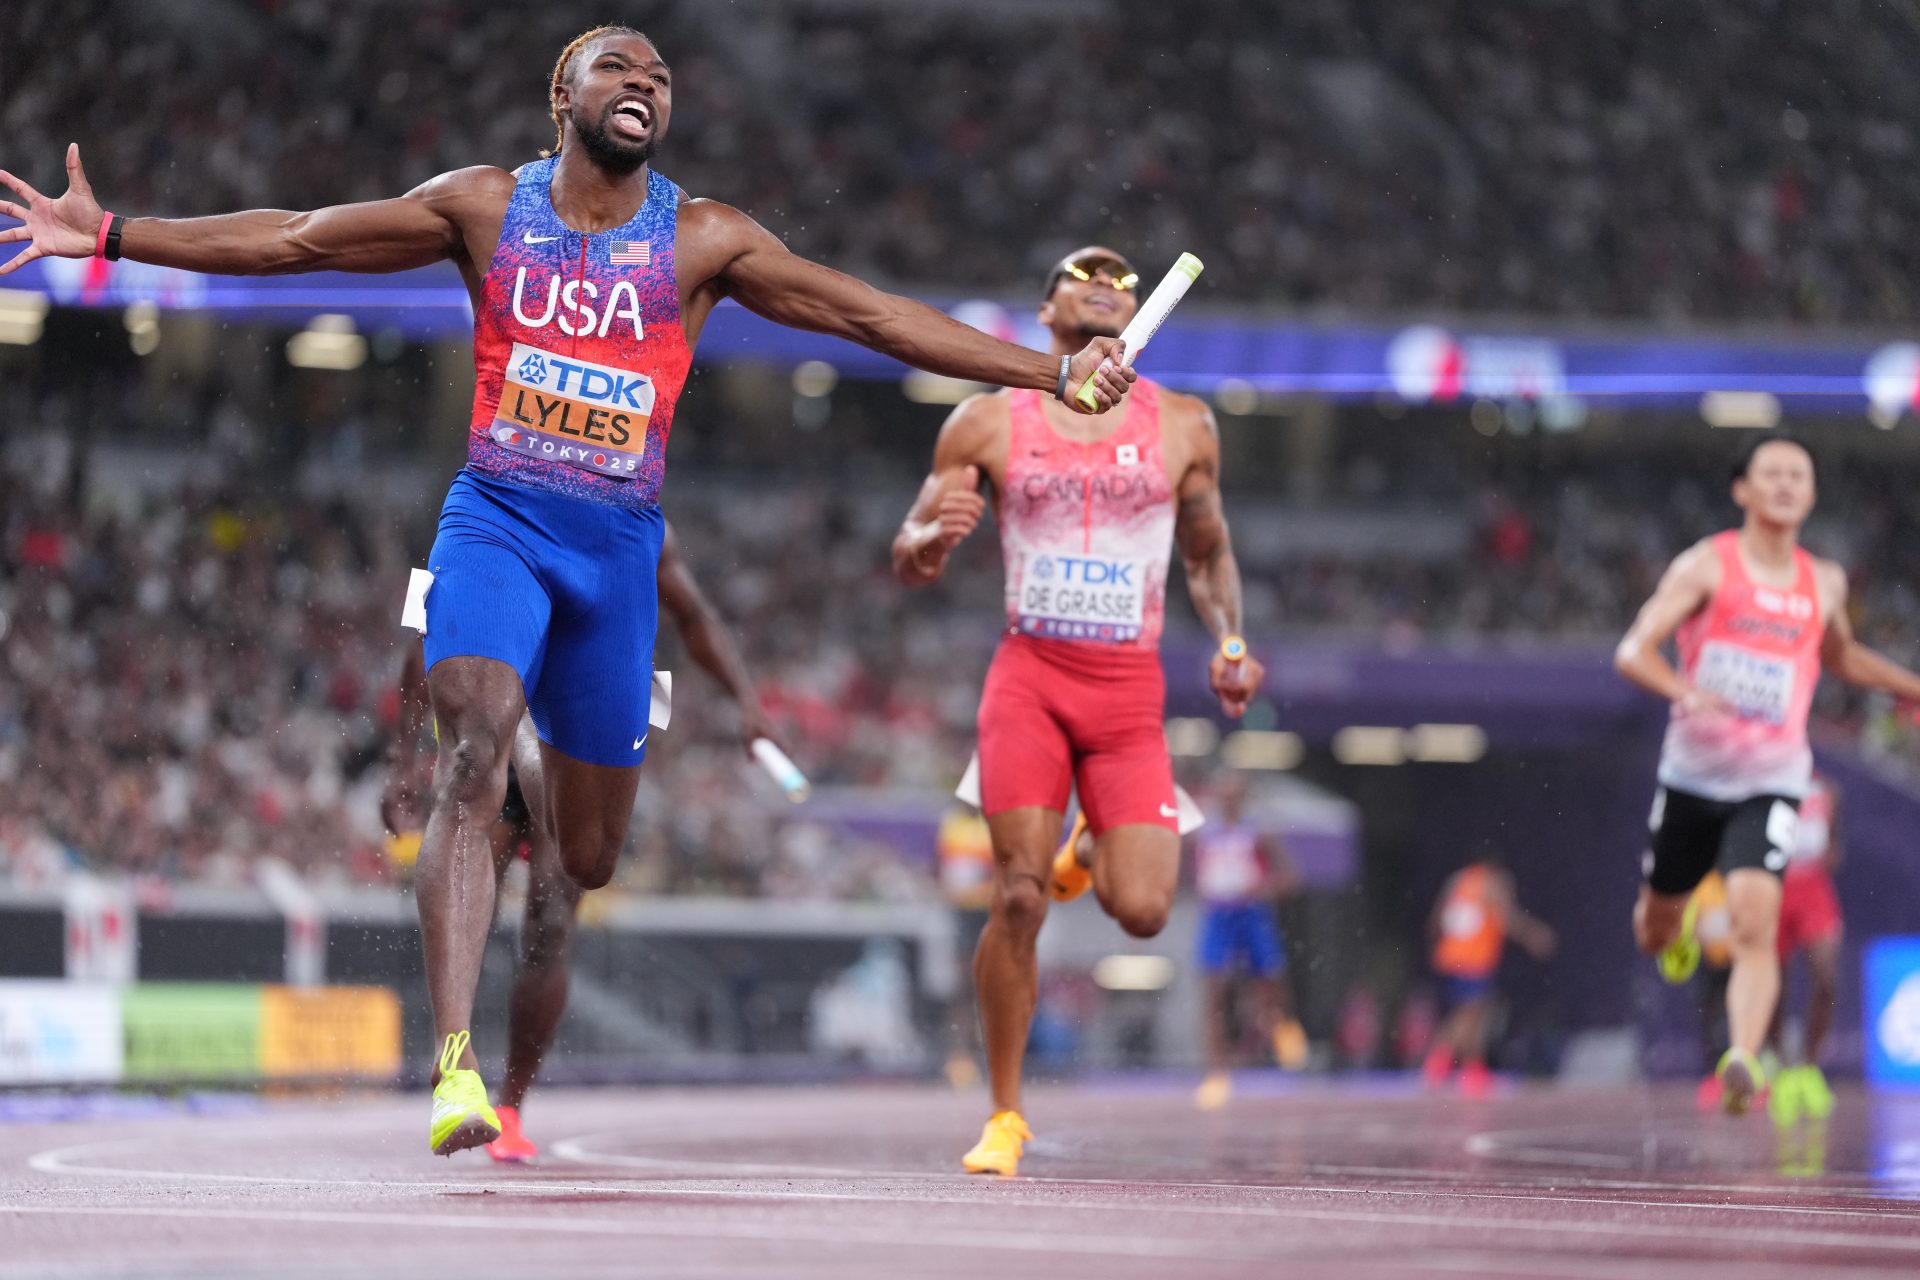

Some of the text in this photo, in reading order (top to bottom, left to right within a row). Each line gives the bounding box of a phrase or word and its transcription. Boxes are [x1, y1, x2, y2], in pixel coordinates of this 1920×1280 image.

[512, 266, 644, 341] USA
[550, 358, 647, 409] TDK
[513, 389, 631, 446] LYLES
[1023, 473, 1150, 501] CANADA
[1056, 557, 1133, 587] TDK
[1025, 585, 1136, 620] DE GRASSE
